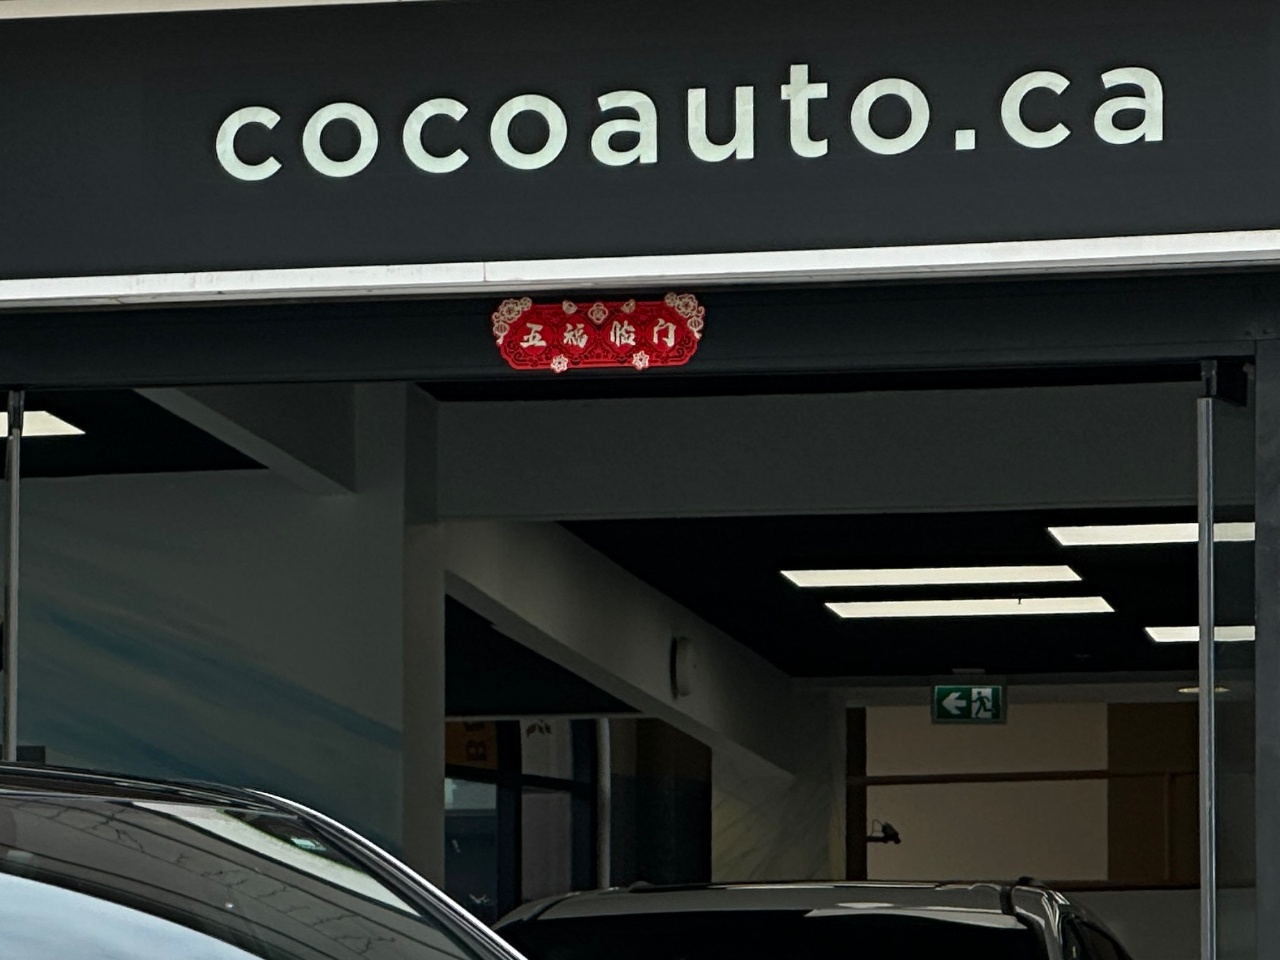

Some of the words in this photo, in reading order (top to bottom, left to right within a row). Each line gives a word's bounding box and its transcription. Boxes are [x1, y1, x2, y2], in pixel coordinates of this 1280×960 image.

[215, 62, 1166, 182] cocoauto.ca
[519, 318, 677, 349] 五福临门
